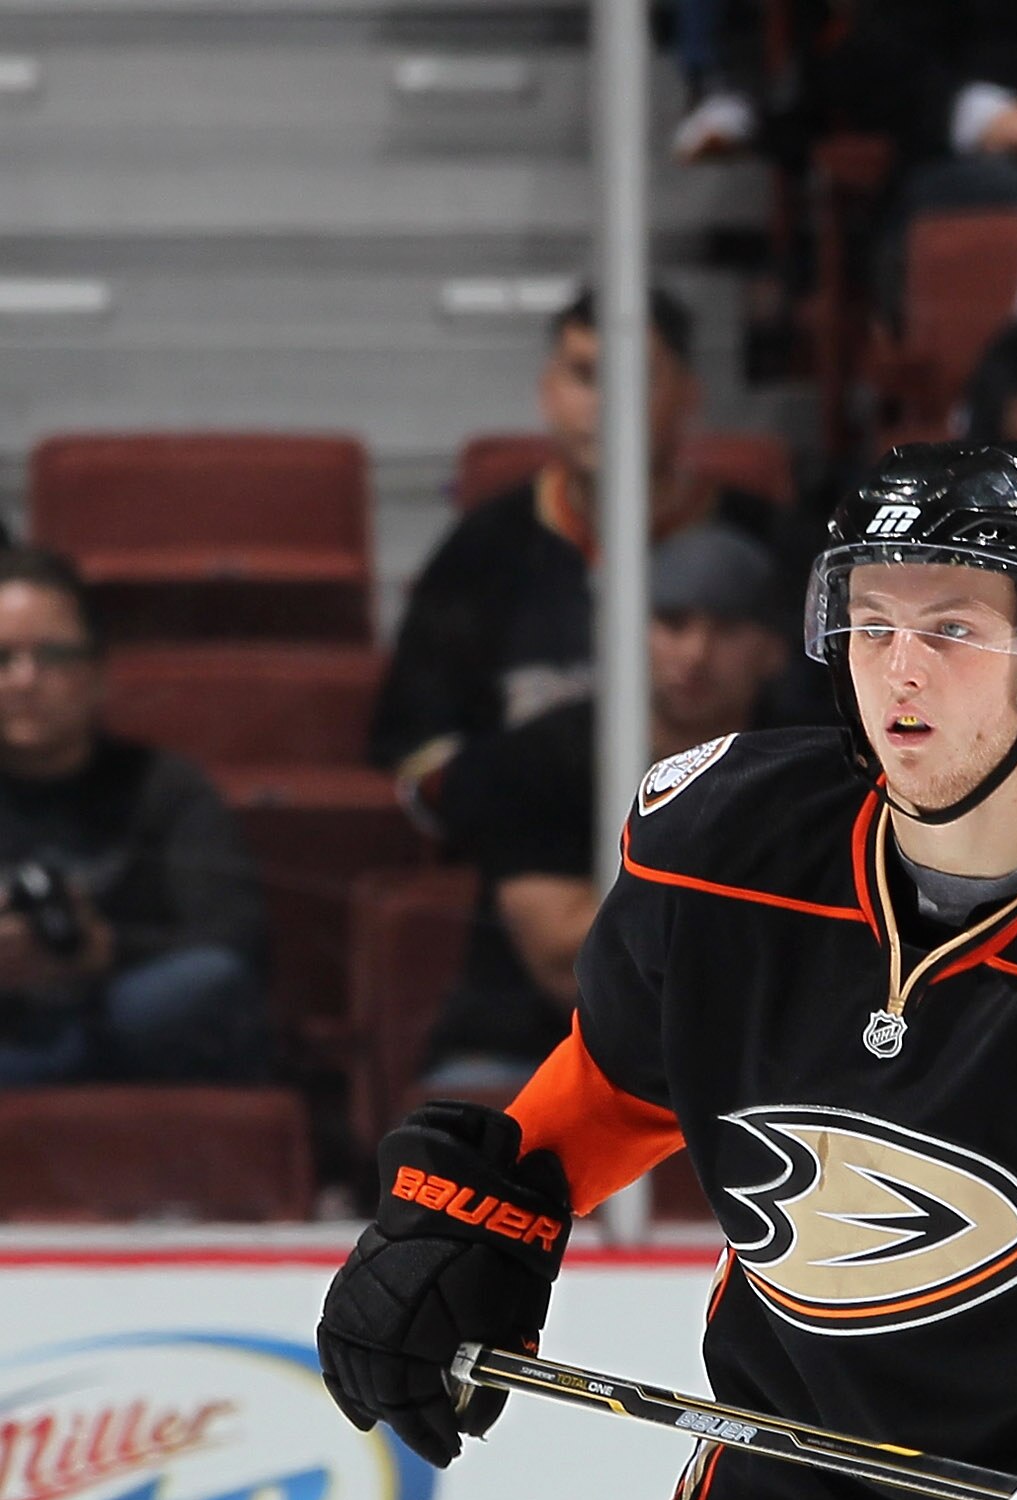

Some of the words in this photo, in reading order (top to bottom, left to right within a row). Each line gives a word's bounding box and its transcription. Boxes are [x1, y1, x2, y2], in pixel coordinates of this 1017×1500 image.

[871, 1022, 899, 1047] NHL
[392, 1165, 562, 1252] BAUER
[675, 1410, 758, 1444] BAUER
